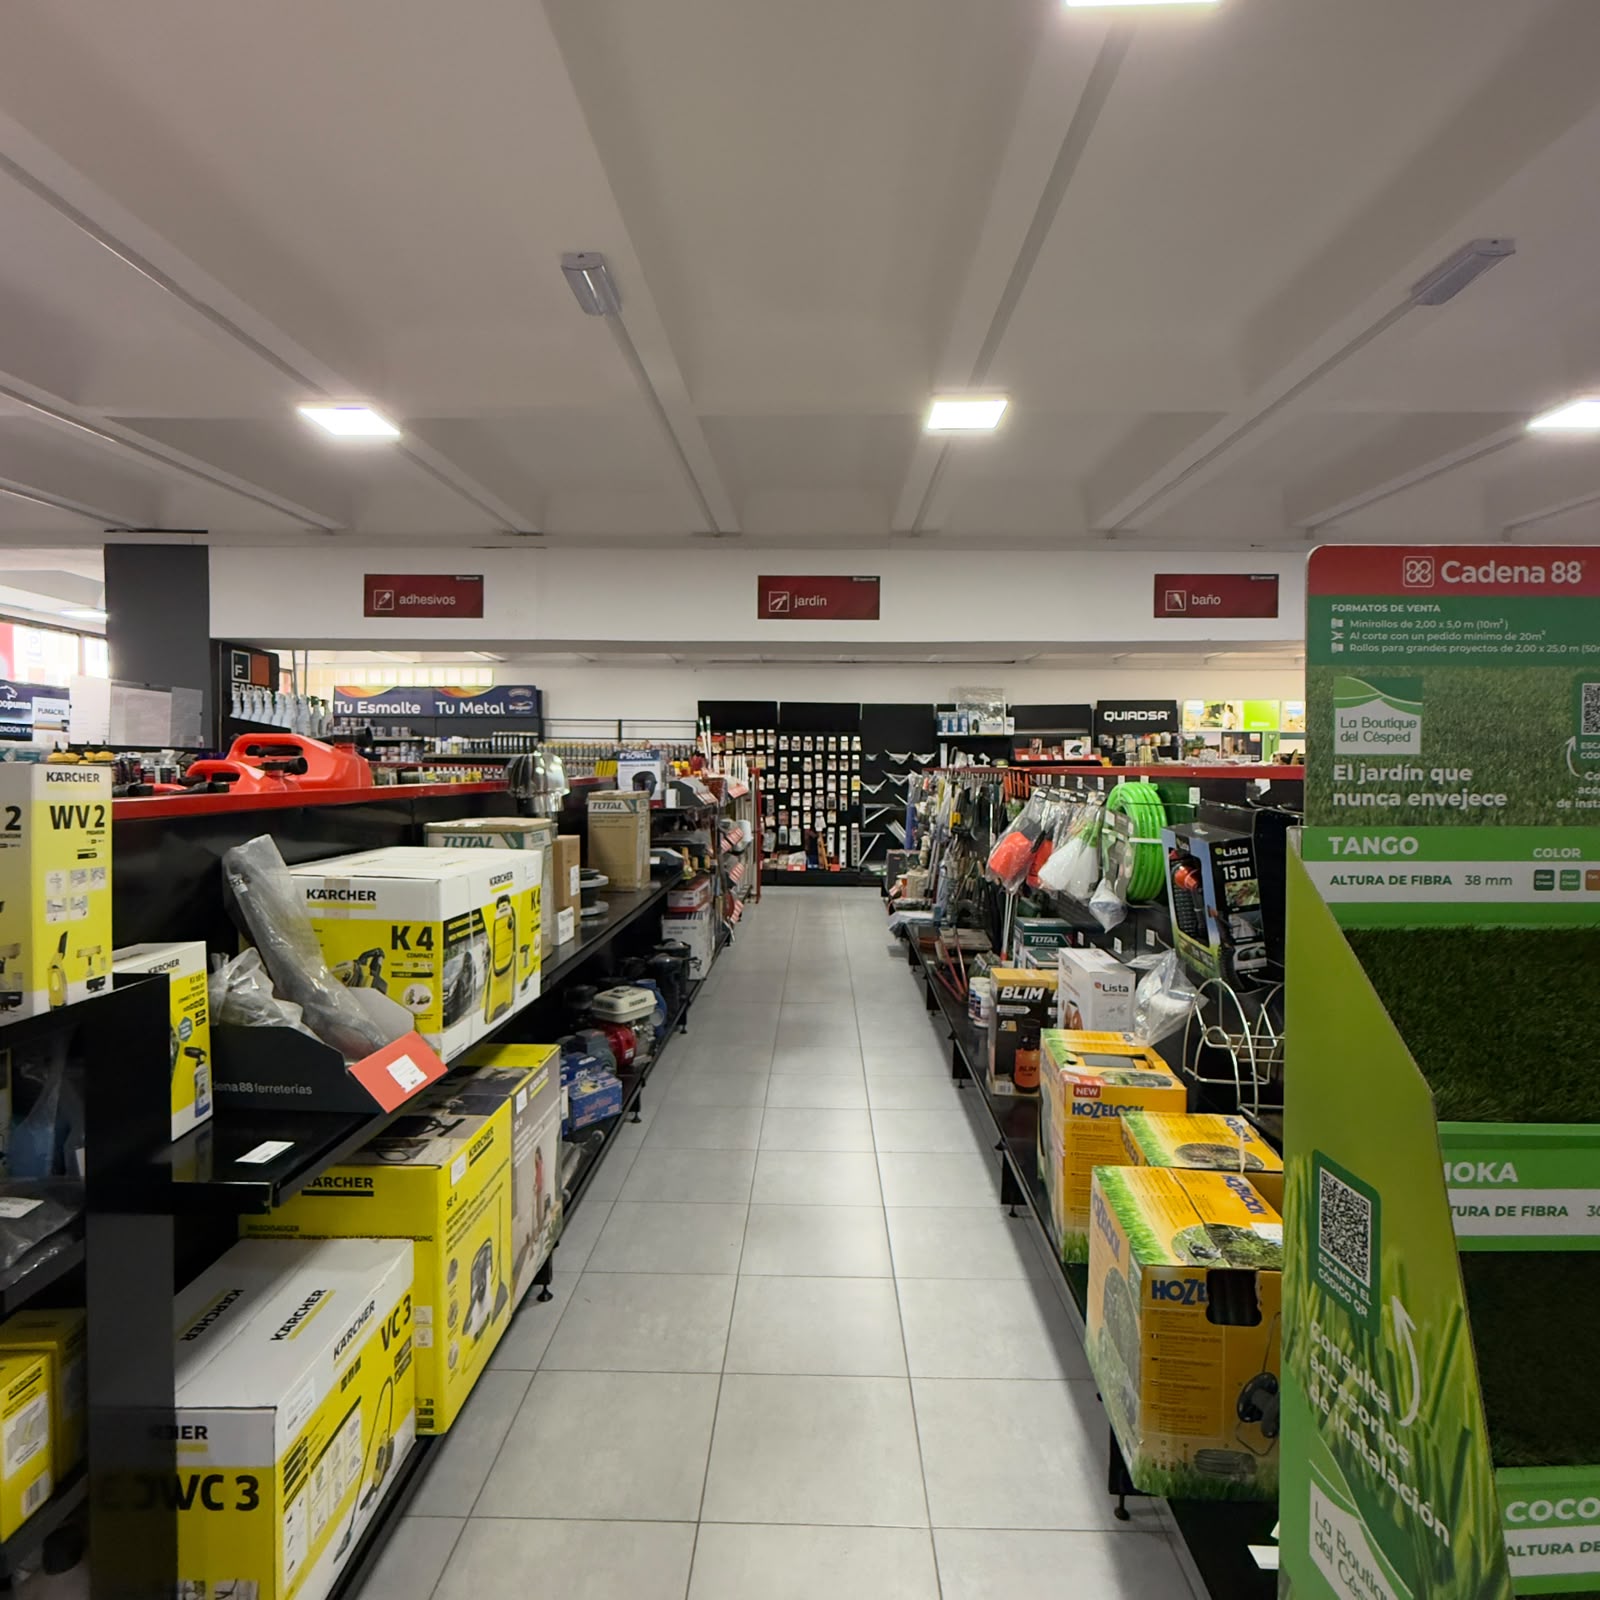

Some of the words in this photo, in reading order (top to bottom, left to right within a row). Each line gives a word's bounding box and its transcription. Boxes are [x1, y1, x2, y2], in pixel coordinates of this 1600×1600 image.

[1441, 560, 1546, 584] Cadena
[1551, 561, 1582, 584] 88
[399, 593, 456, 606] adhesivos
[794, 594, 827, 608] jardín
[1191, 594, 1221, 605] baño
[1331, 604, 1389, 613] FORMATOS
[1390, 604, 1405, 613] DE
[1406, 604, 1441, 613] VENTA
[1350, 619, 1399, 629] Minirollos
[1400, 620, 1413, 629] de
[1415, 620, 1437, 630] 2,00
[1463, 621, 1474, 629] m
[1349, 632, 1360, 640] Al
[1361, 632, 1389, 641] corte
[1390, 633, 1409, 641] con
[1411, 633, 1425, 641] un
[1427, 631, 1462, 643] pedido
[1504, 632, 1517, 641] de
[1349, 643, 1380, 652] Rollos
[1381, 644, 1405, 655] para
[1406, 643, 1447, 655] grandes
[1448, 643, 1499, 655] proyectos
[1500, 644, 1513, 653] de
[1515, 644, 1537, 655] 2,00
[1568, 645, 1580, 653] m
[335, 701, 353, 715] Tu
[357, 700, 421, 715] Esmalte
[435, 701, 455, 715] Tu
[459, 701, 506, 715] Metal
[1103, 710, 1168, 722] QUIADSA
[1340, 717, 1357, 729] La
[1361, 716, 1417, 732] Boutique
[1340, 731, 1359, 742] del
[1362, 730, 1411, 744] Césped
[46, 771, 100, 783] KÄRCHER
[1333, 765, 1353, 781] El
[1356, 764, 1424, 784] jardín
[1430, 766, 1473, 785] que
[592, 802, 623, 810] TOTAL
[1333, 792, 1401, 806] nunca
[1407, 788, 1508, 809] envejece
[1556, 798, 1571, 808] de
[5, 805, 22, 831] 2
[49, 804, 91, 830] WV
[94, 804, 105, 828] 2
[442, 835, 495, 849] TOTAL
[1328, 836, 1419, 855] TANGO
[1222, 846, 1249, 857] Lista
[1532, 847, 1582, 858] COLOR
[1222, 865, 1238, 880] 15
[1239, 866, 1252, 879] m
[1330, 875, 1385, 886] ALTURA
[1388, 875, 1407, 886] DE
[1411, 875, 1453, 886] FIBRA
[1464, 874, 1481, 886] 38
[1485, 877, 1513, 886] mm
[306, 888, 377, 902] KÄRCHER
[391, 925, 412, 951] K
[415, 926, 435, 951] 4
[1030, 935, 1060, 944] TOTAL
[1000, 985, 1046, 1001] BLIM
[1102, 983, 1130, 993] Lista
[1075, 1087, 1099, 1096] NEW
[306, 1176, 374, 1189] ÄRCHER
[1495, 1205, 1517, 1217] DE
[1520, 1205, 1569, 1217] FIBRA
[1359, 1287, 1372, 1306] EL
[270, 1289, 328, 1341] KÄRCHER
[403, 1293, 412, 1326] 3
[1353, 1299, 1368, 1319] QR
[333, 1299, 376, 1361] KÄRCHER
[1309, 1320, 1391, 1414] Consulta
[1309, 1352, 1410, 1467] accesorios
[1309, 1382, 1330, 1416] de
[1333, 1404, 1450, 1548] instalación
[235, 1474, 260, 1512] 3
[1505, 1496, 1600, 1523] COCO
[1314, 1500, 1332, 1538] La
[1314, 1531, 1334, 1566] del
[1505, 1542, 1575, 1557] ALTURA
